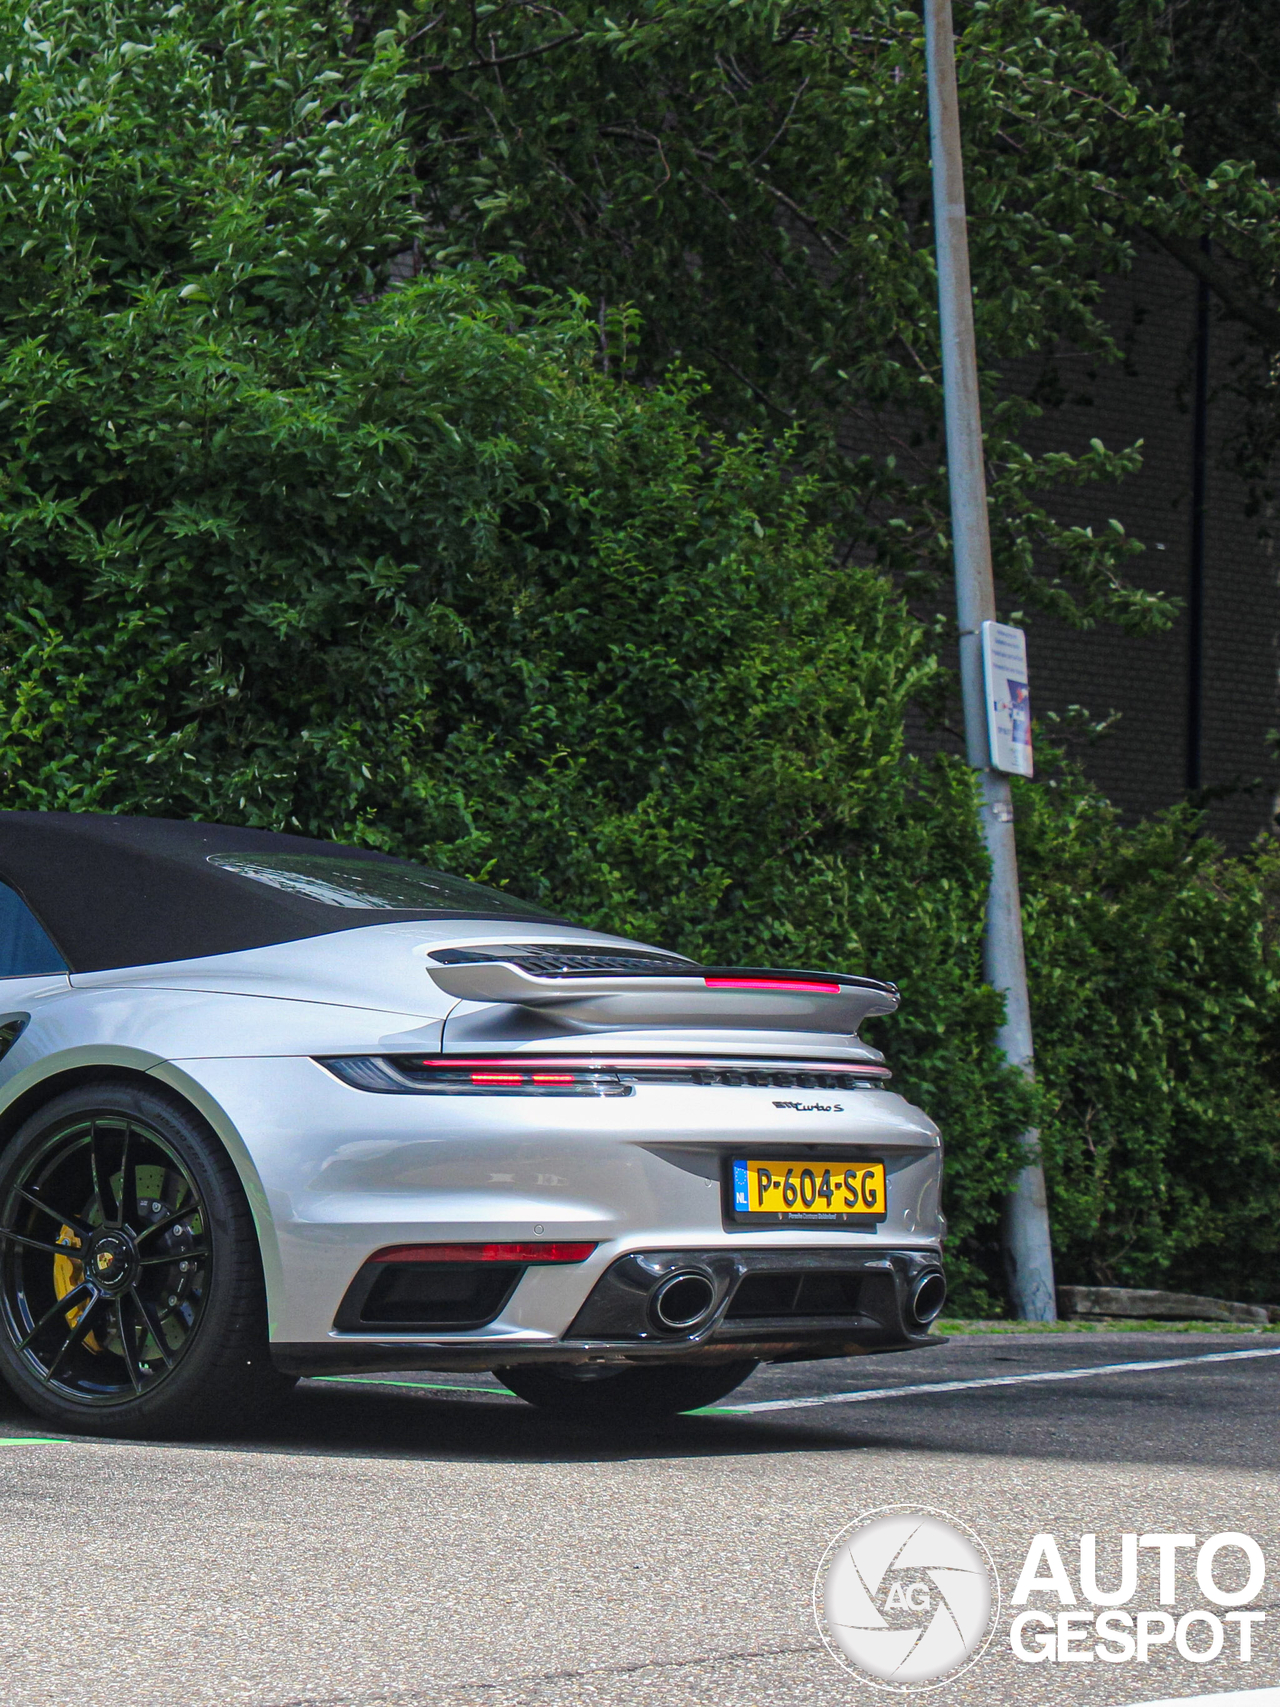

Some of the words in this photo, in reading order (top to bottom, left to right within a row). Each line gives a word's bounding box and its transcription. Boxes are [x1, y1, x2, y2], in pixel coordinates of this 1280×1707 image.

[833, 1104, 845, 1112] S
[756, 1167, 878, 1209] P-604-SG
[736, 1191, 747, 1204] NL
